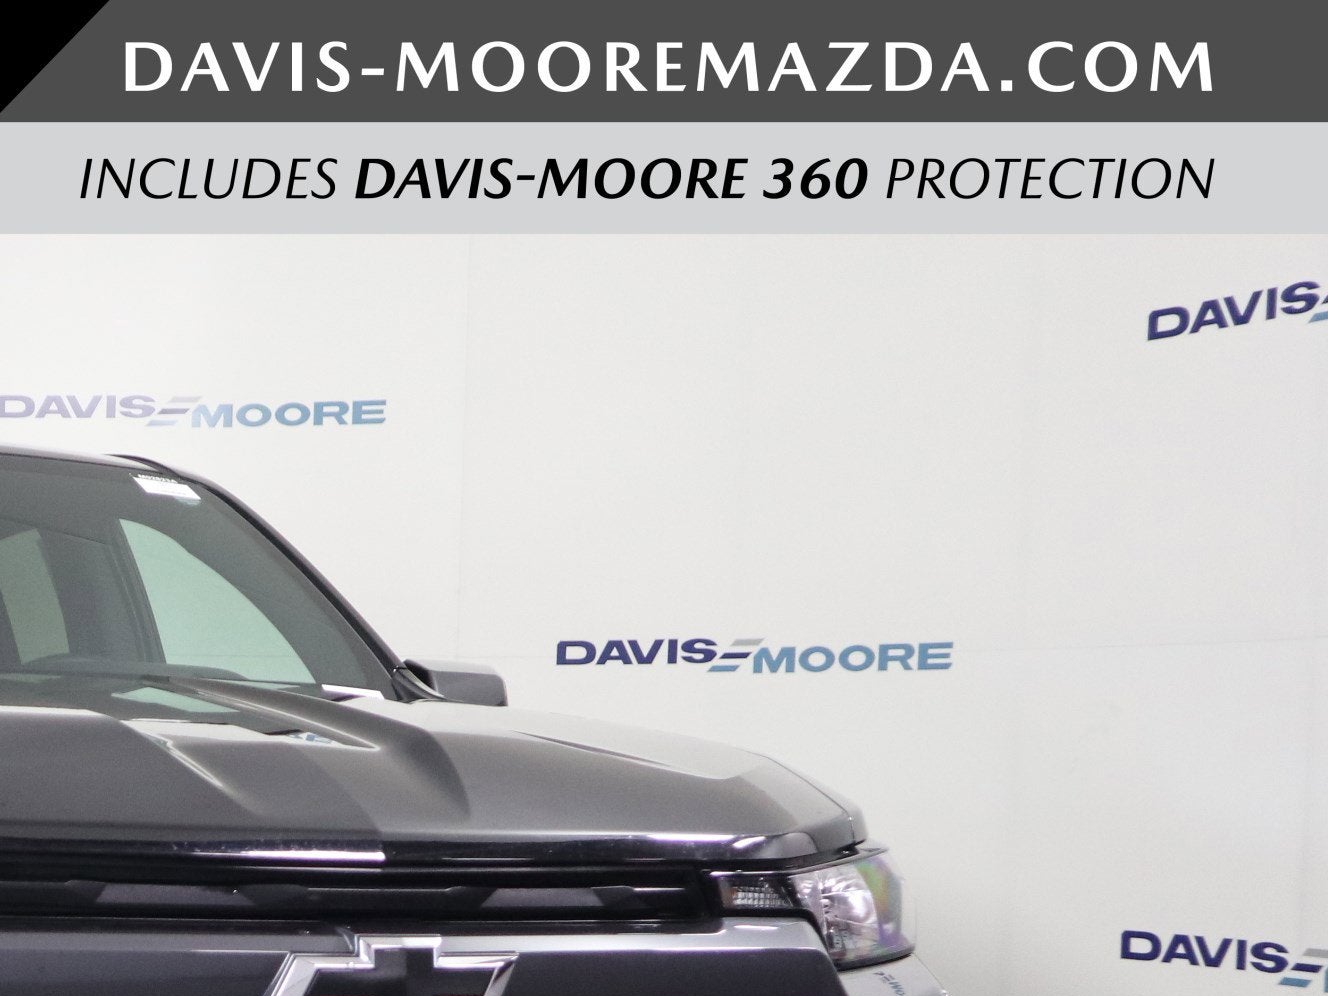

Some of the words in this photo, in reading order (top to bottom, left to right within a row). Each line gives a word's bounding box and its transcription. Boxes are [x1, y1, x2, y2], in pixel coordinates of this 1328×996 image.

[1147, 280, 1321, 341] DAVIS
[190, 400, 388, 428] MOORE
[556, 637, 716, 666] DAVIS
[752, 641, 954, 674] MOORE
[1120, 930, 1289, 974] DAVIS
